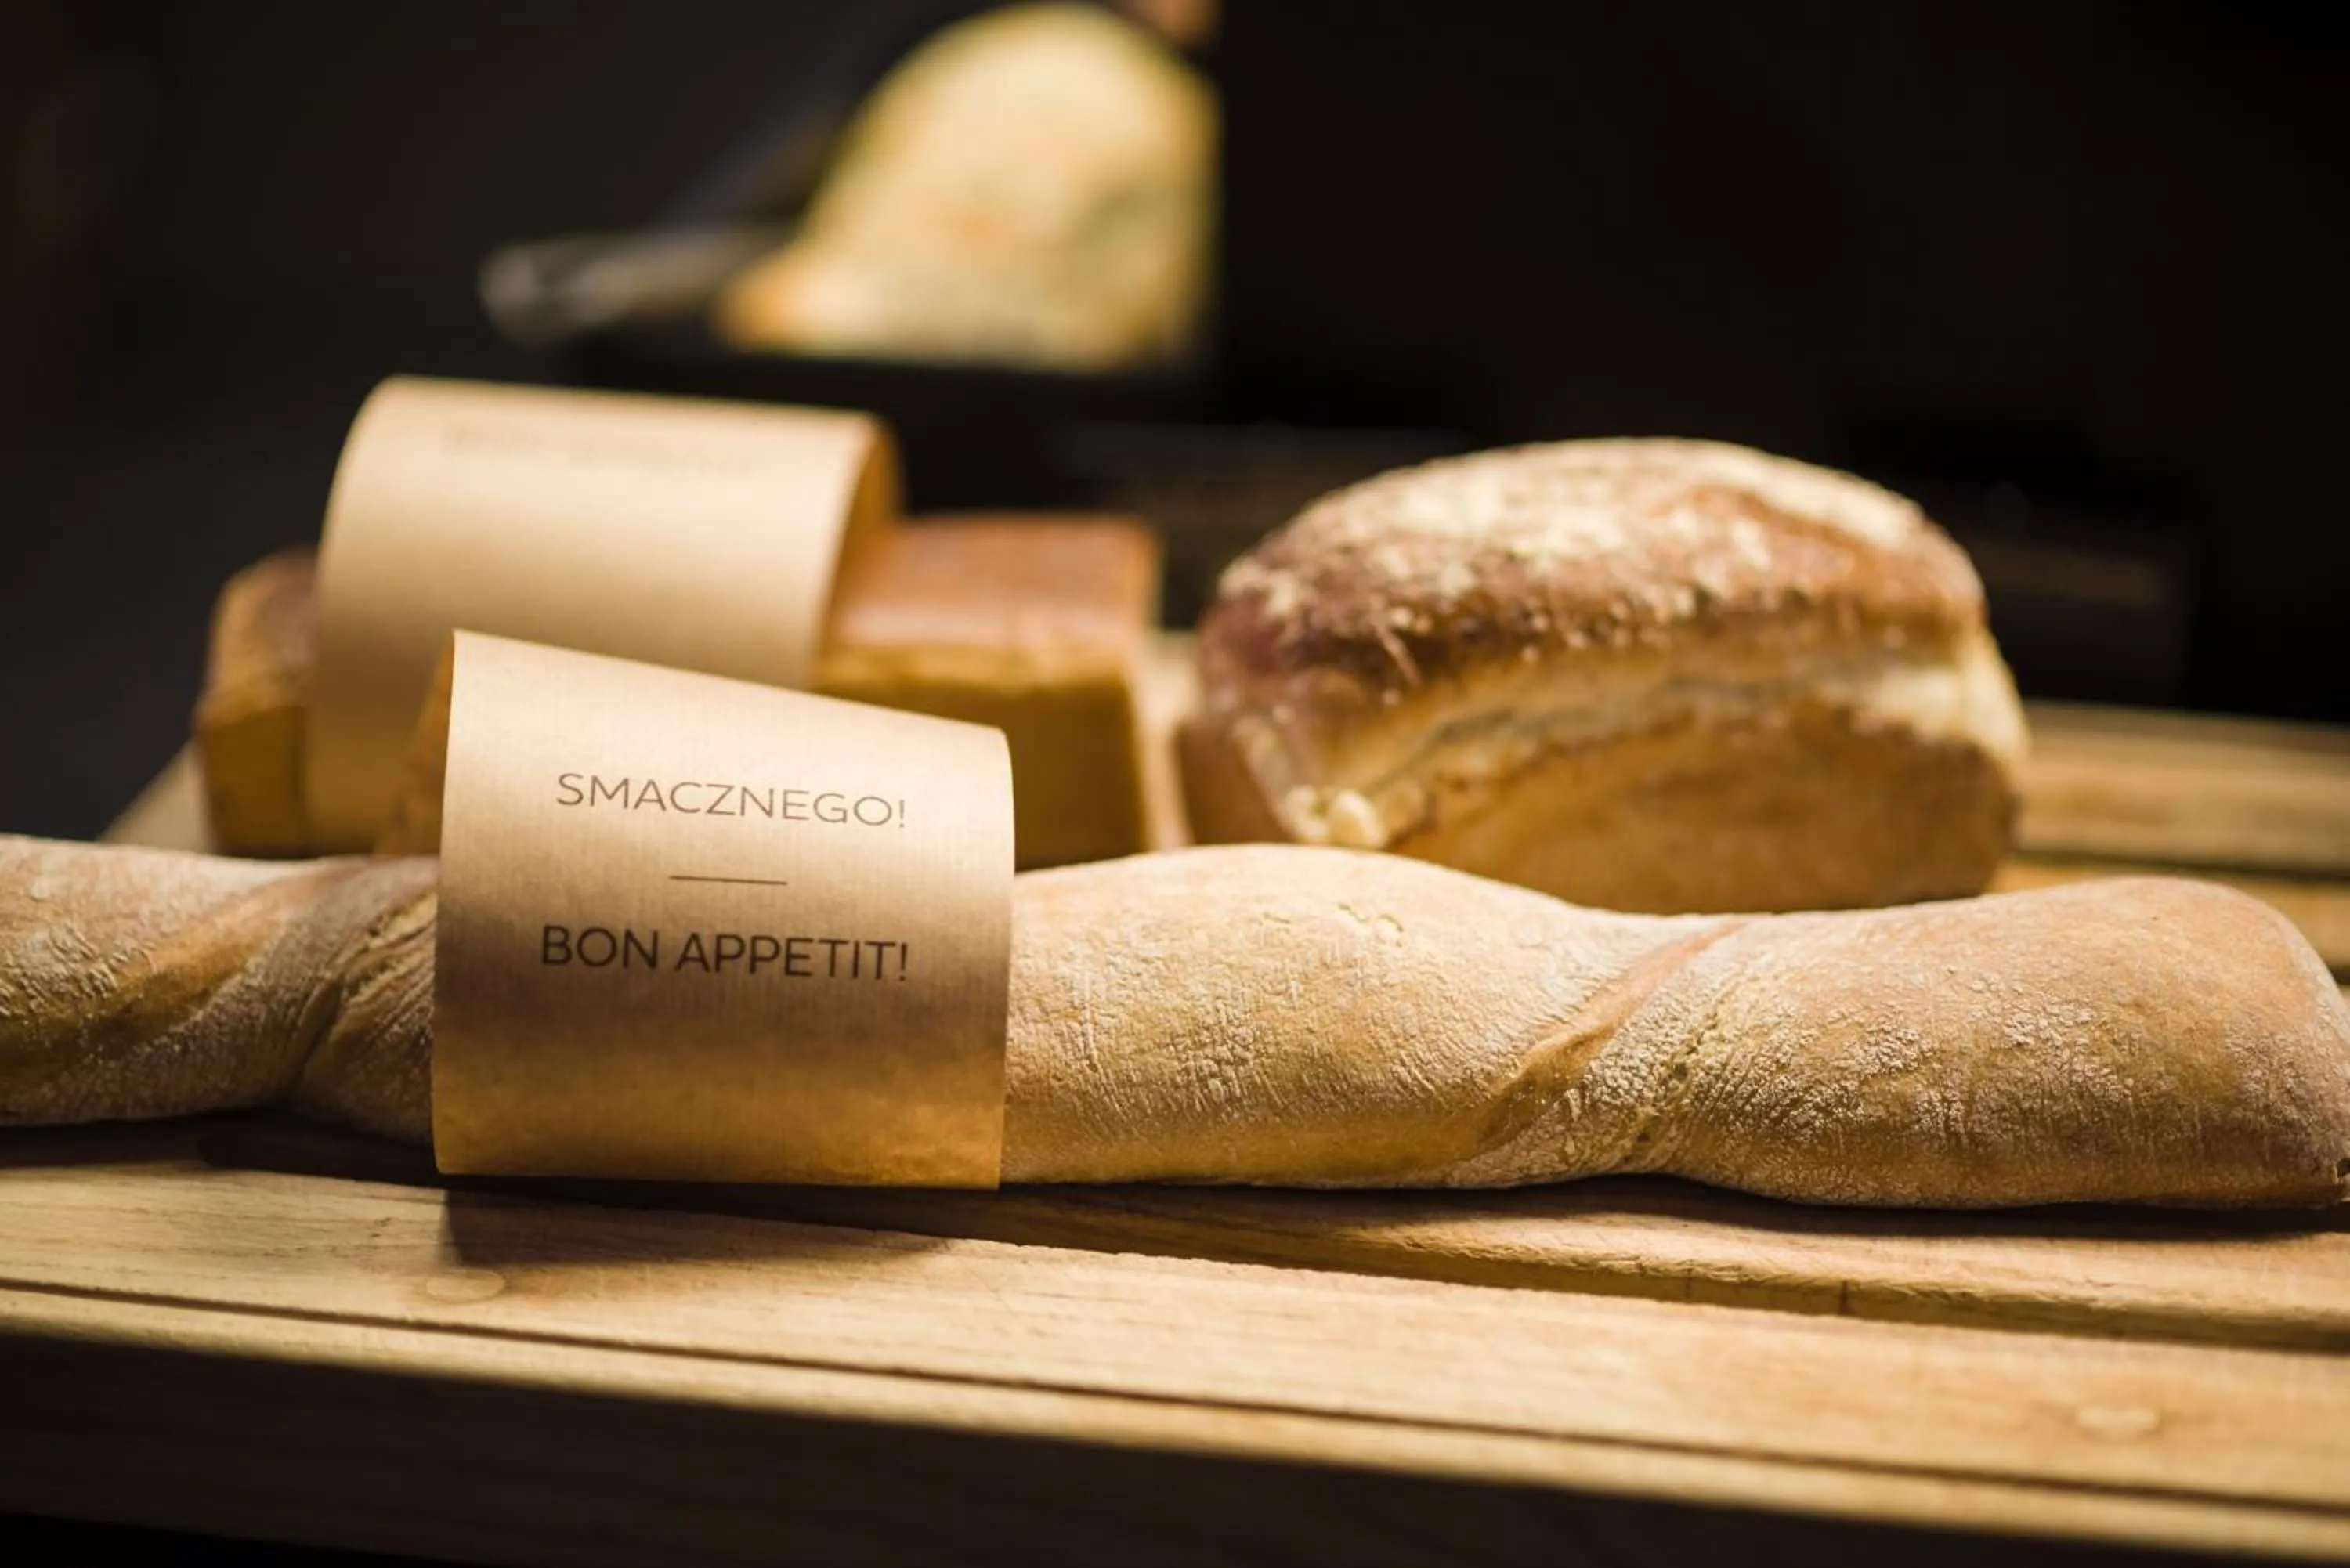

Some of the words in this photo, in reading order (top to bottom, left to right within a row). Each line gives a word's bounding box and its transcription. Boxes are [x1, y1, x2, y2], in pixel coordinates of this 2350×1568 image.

[556, 773, 906, 828] SMACZNEGO!
[542, 925, 659, 970] BON
[674, 932, 909, 981] APPETIT!
